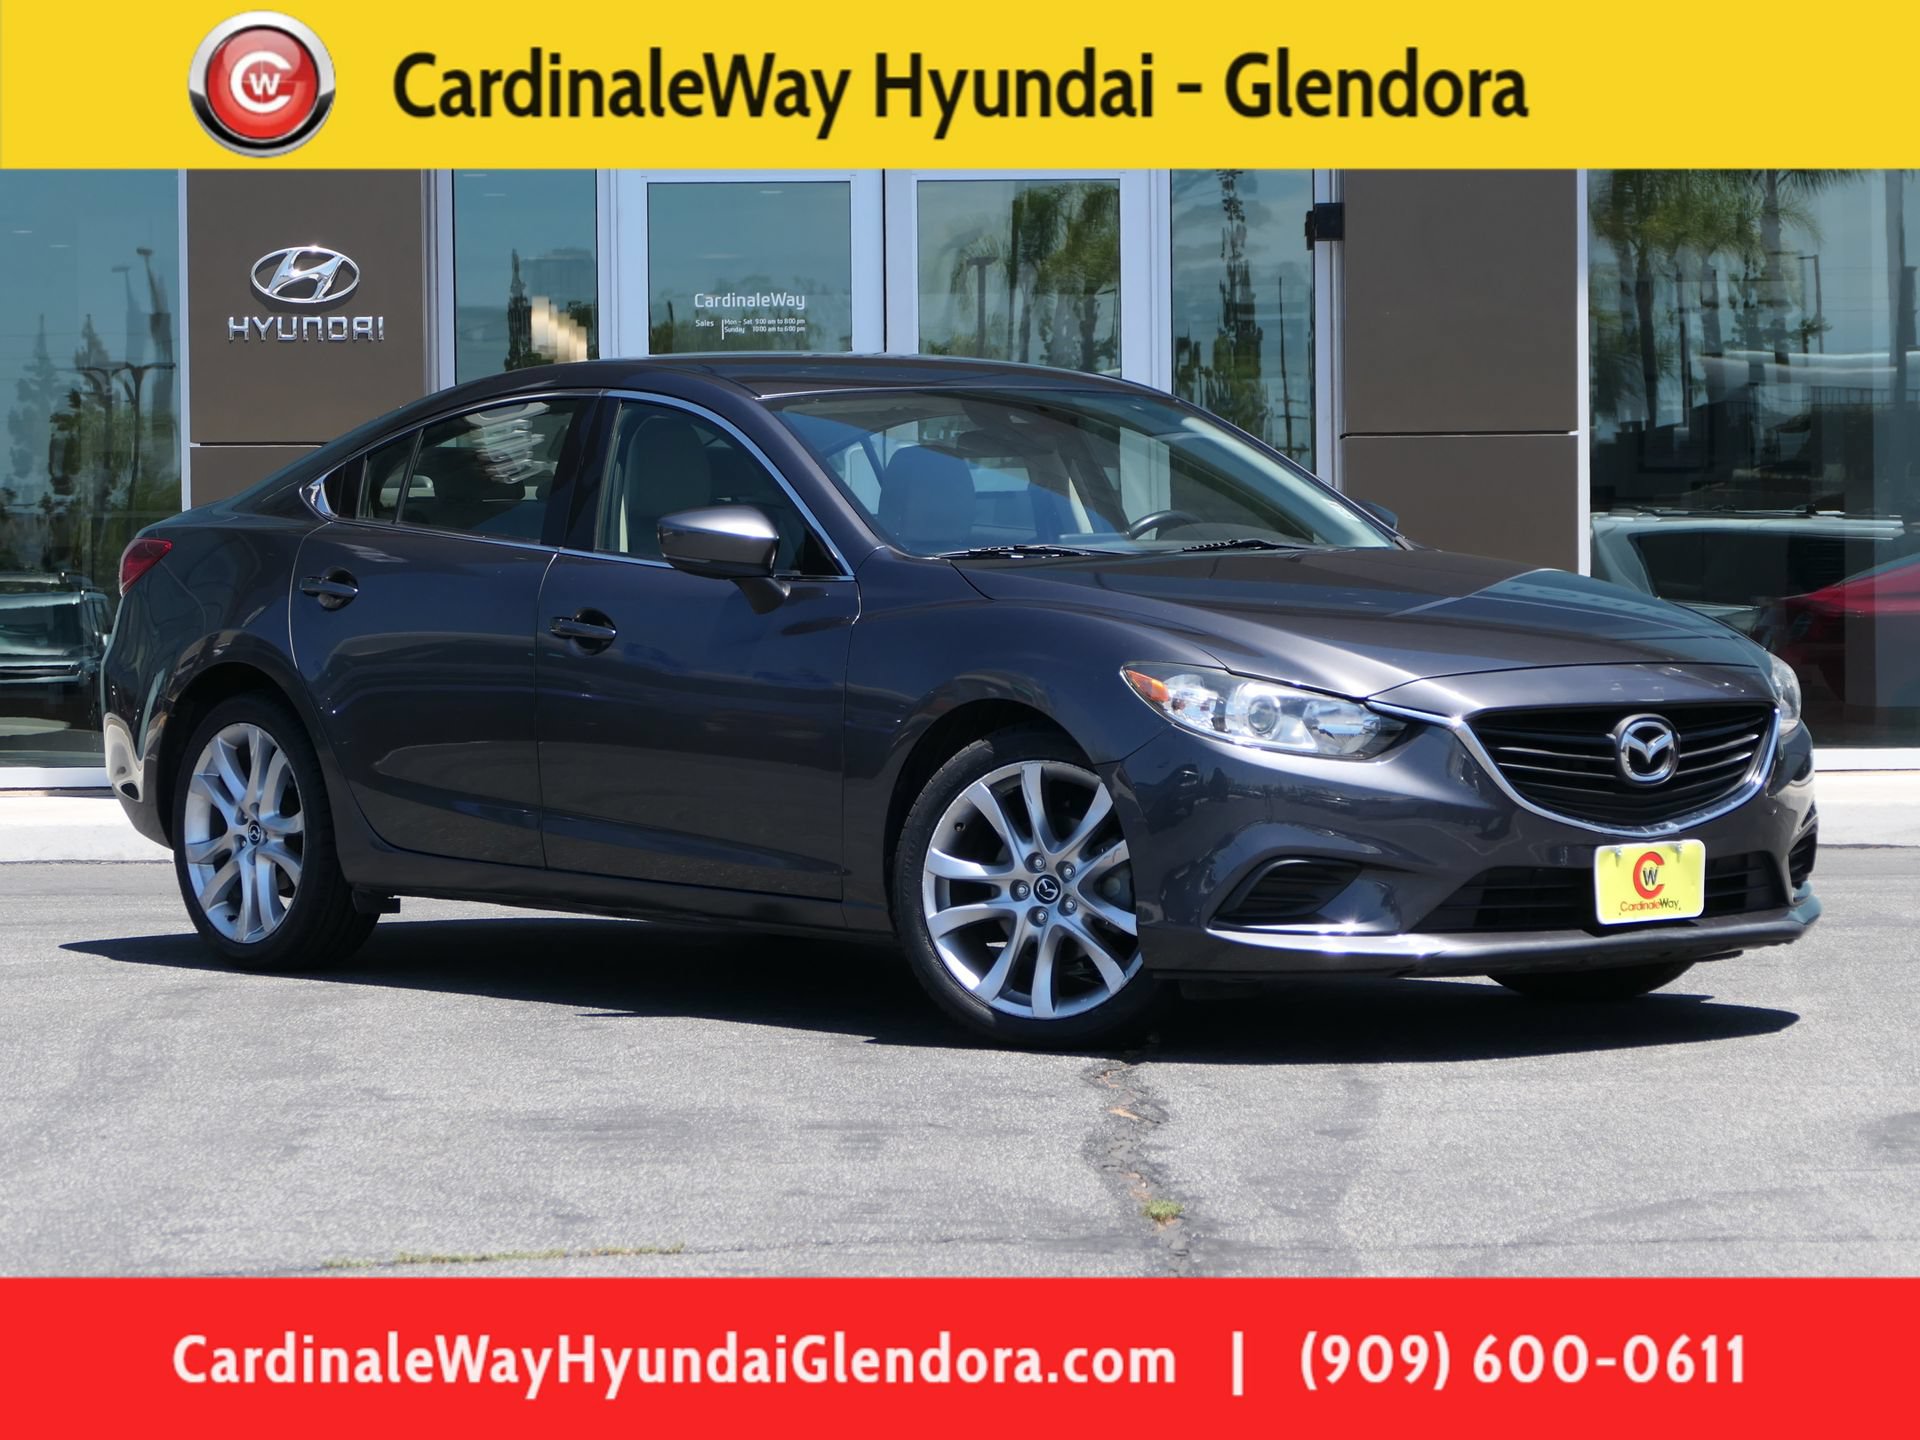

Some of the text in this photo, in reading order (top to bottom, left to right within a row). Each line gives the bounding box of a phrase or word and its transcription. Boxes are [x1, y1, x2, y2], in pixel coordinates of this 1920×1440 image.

[694, 292, 806, 310] CardinaleWay
[228, 316, 385, 341] HYUNDAI
[695, 319, 714, 327] Sales
[1620, 898, 1679, 911] CardinaleWay
